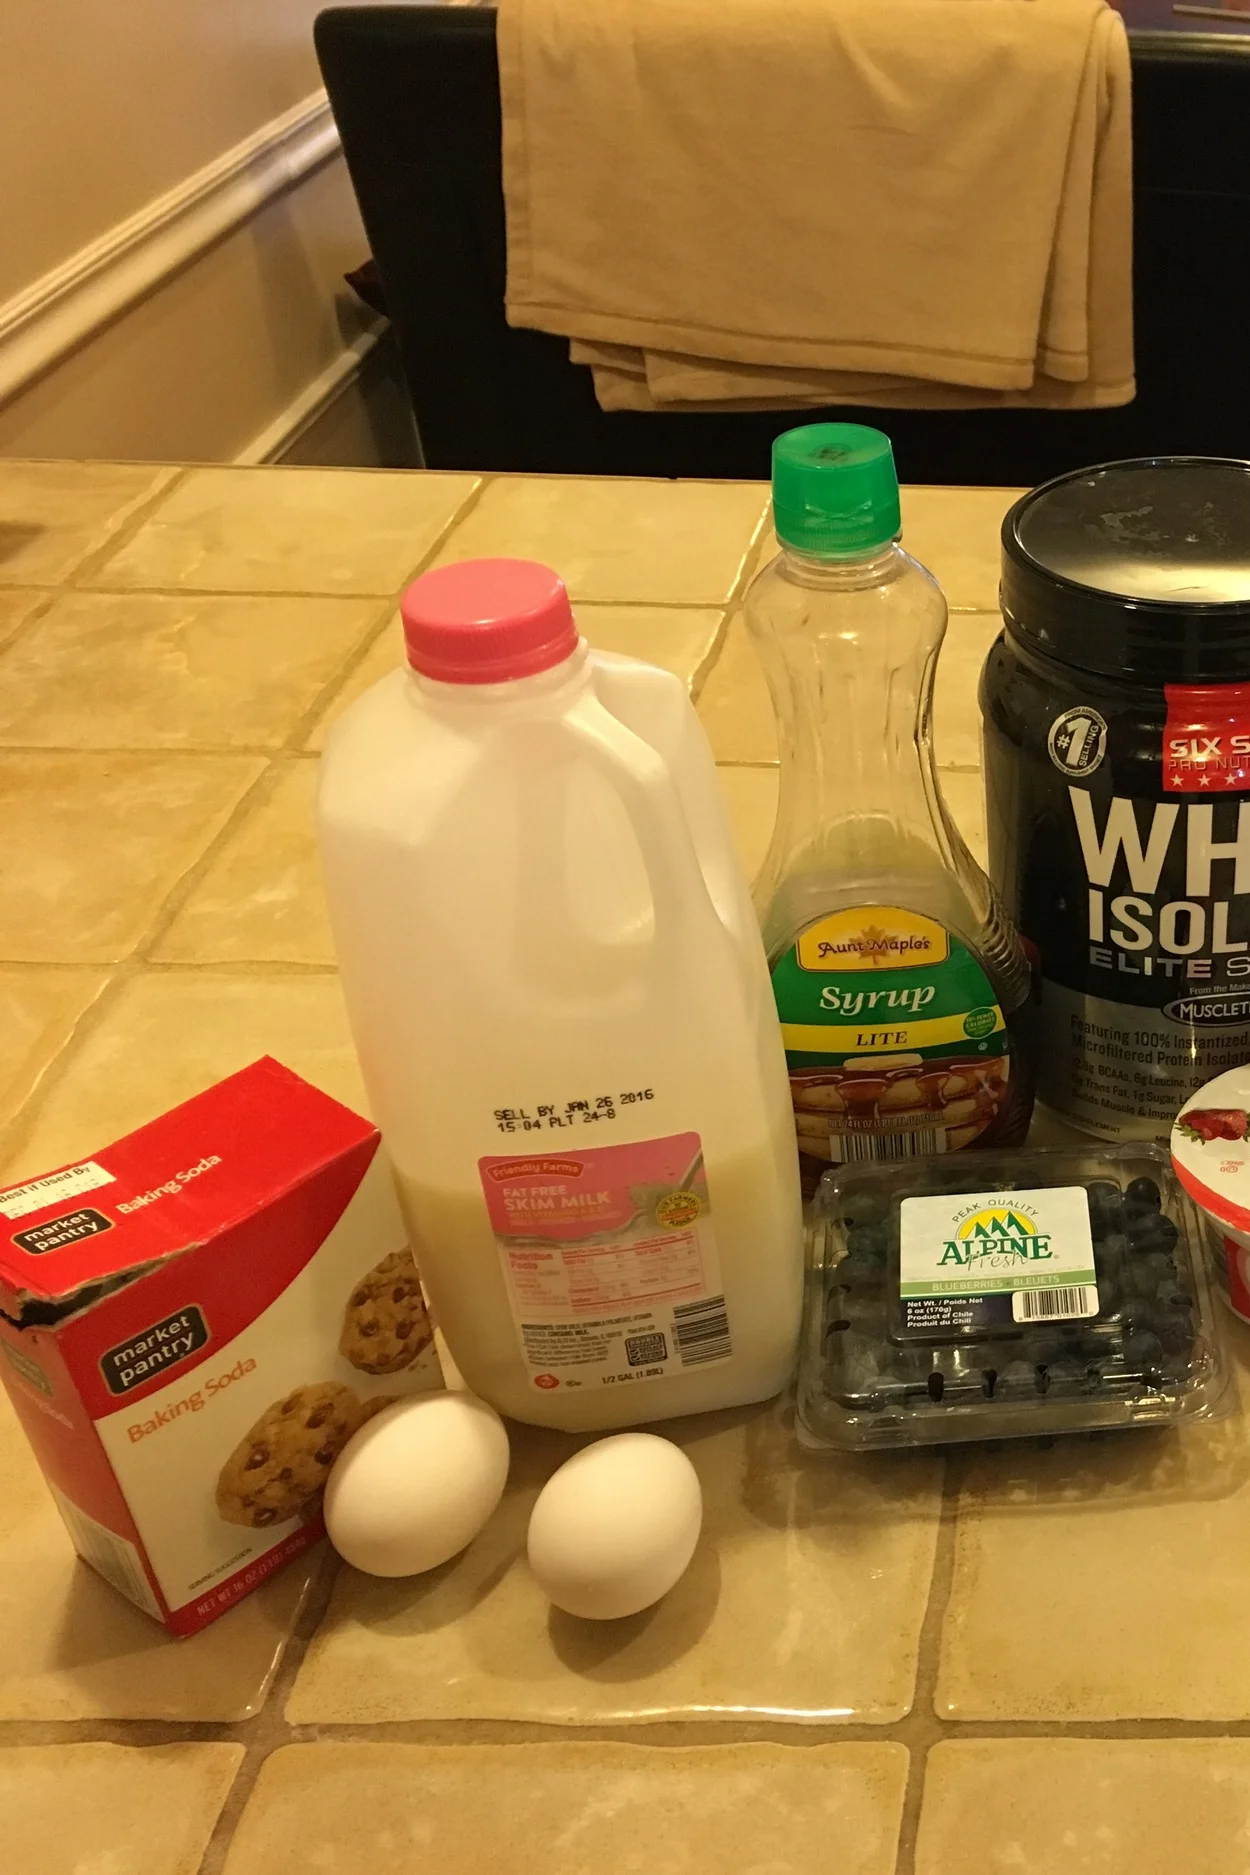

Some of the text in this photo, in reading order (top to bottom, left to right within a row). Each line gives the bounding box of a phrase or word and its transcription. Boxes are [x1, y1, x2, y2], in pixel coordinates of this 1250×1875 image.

[1079, 725, 1099, 767] SELLING
[1169, 737, 1222, 758] SIX
[1169, 758, 1206, 771] PRO
[818, 936, 931, 958] Aunt Maple's
[1089, 945, 1211, 978] ELITE
[819, 985, 936, 1016] Syrup
[1190, 986, 1212, 995] From
[1213, 985, 1227, 993] the
[856, 1030, 908, 1047] LITE
[1071, 1014, 1250, 1050] Featuring 100% Instantized,
[1071, 1033, 1152, 1064] Microfiltered
[1157, 1051, 1203, 1066] Protein
[1098, 1065, 1188, 1088] BCAAs, 6g Leucine,
[1086, 1077, 1177, 1105] Trans Fat, 1g Sugar,
[494, 1088, 654, 1121] SELL BY JAN 26 2016
[1101, 1097, 1135, 1115] Muscle
[549, 1114, 573, 1128] PLT
[583, 1108, 616, 1123] 24-8
[40, 1170, 72, 1188] Used
[72, 1166, 91, 1180] By
[493, 1162, 579, 1176] Friendly Farms
[115, 1180, 182, 1215] Baking
[176, 1155, 222, 1184] Soda
[503, 1185, 567, 1198] FAT FREE
[503, 1191, 610, 1212] SKIM MILK
[951, 1199, 1040, 1223] PEAK QUALITY
[24, 1212, 90, 1242] market
[34, 1220, 98, 1251] pantry
[936, 1235, 1053, 1266] ALPINE
[966, 1251, 1028, 1271] Fresh
[932, 1276, 1060, 1291] BLUEBERRIES BLEUETS
[943, 1298, 967, 1307] Poids
[907, 1313, 940, 1322] Product
[907, 1320, 938, 1328] Produit
[113, 1315, 190, 1367] market
[119, 1332, 193, 1387] pantry
[602, 1373, 634, 1385] 1/2 GAL
[127, 1390, 206, 1443] Baking
[205, 1358, 257, 1396] Soda
